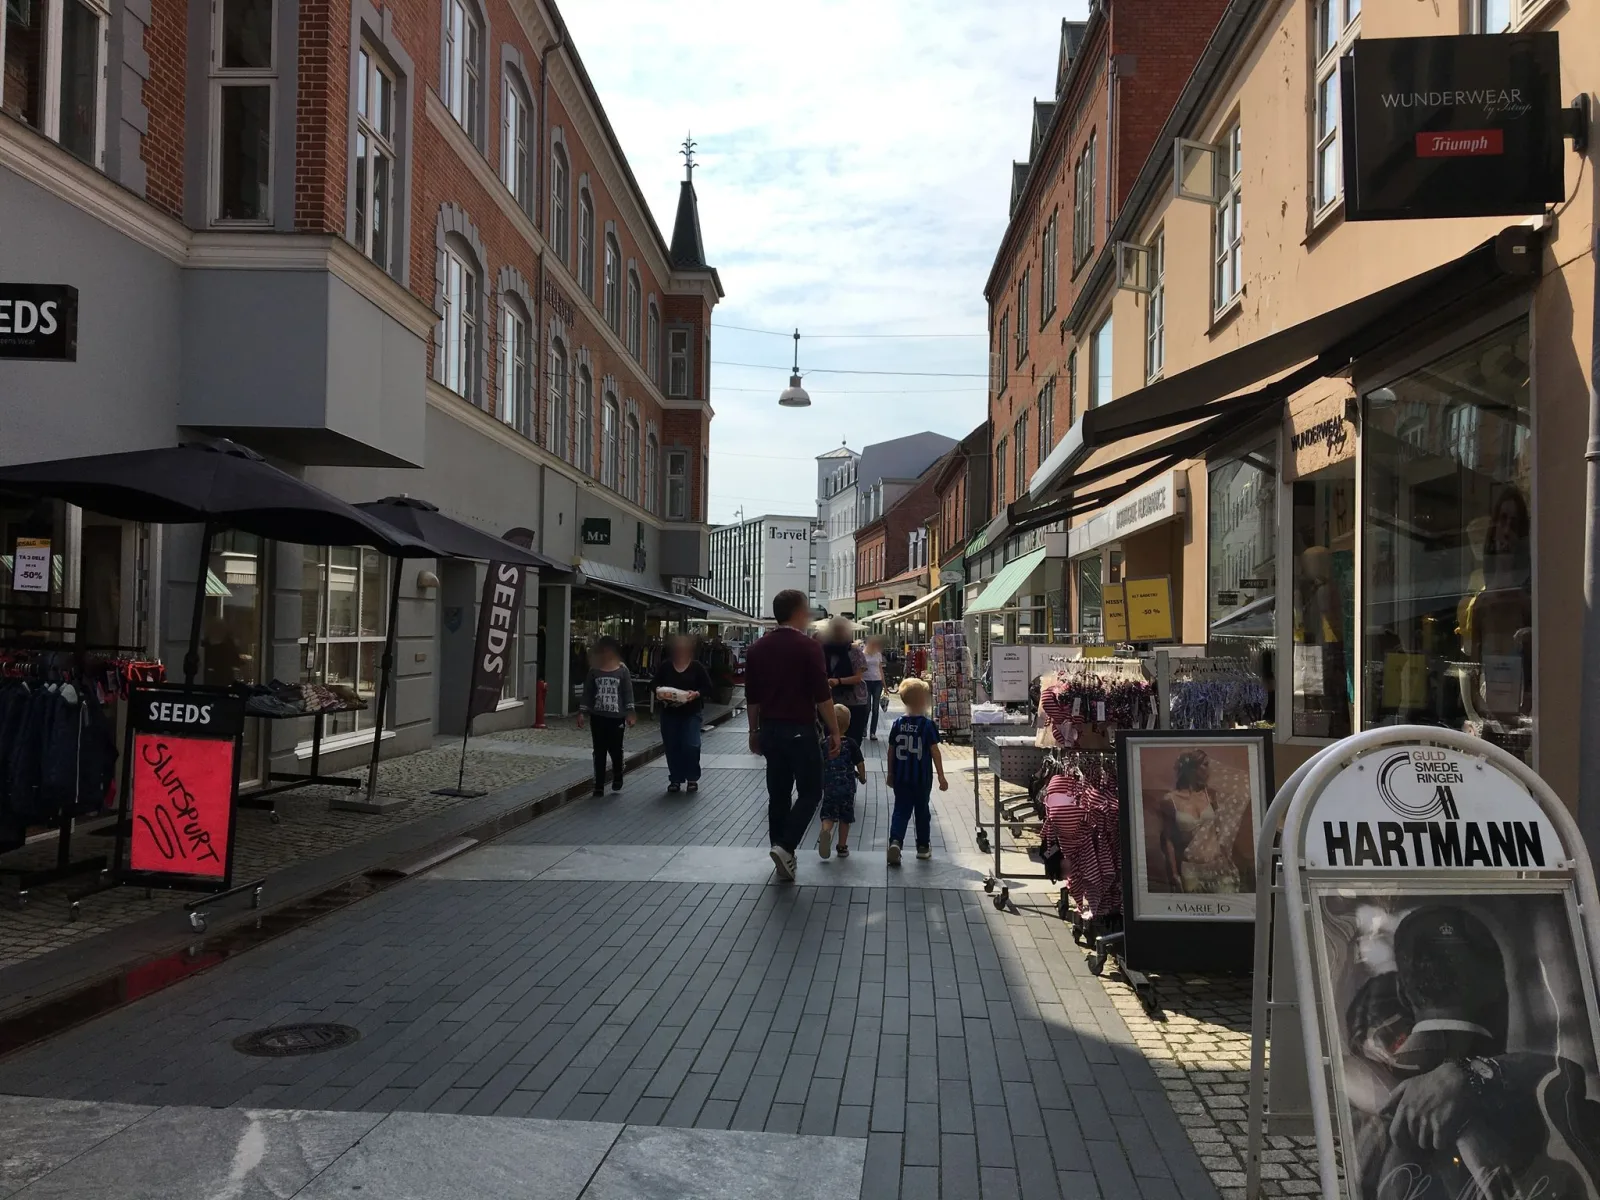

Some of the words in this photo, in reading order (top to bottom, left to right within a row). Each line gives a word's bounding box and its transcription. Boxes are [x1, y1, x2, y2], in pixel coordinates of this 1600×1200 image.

[1381, 88, 1522, 108] WUNDERWEAR
[1431, 136, 1488, 152] Triumph
[1290, 414, 1344, 452] WUNDERWEAR
[587, 531, 608, 541] Mr
[769, 526, 807, 541] Torvet
[20, 571, 43, 580] -50%
[483, 563, 518, 674] SEEDS
[149, 702, 211, 725] SEEDS
[895, 734, 923, 761] 24
[1412, 751, 1446, 761] GULD
[1415, 762, 1458, 772] SMEDE
[1417, 773, 1464, 783] RINGEN
[142, 742, 220, 863] SLUTSPURT
[1322, 821, 1546, 867] HARTMANN
[1175, 903, 1213, 913] MARIE
[1217, 903, 1231, 914] JO
